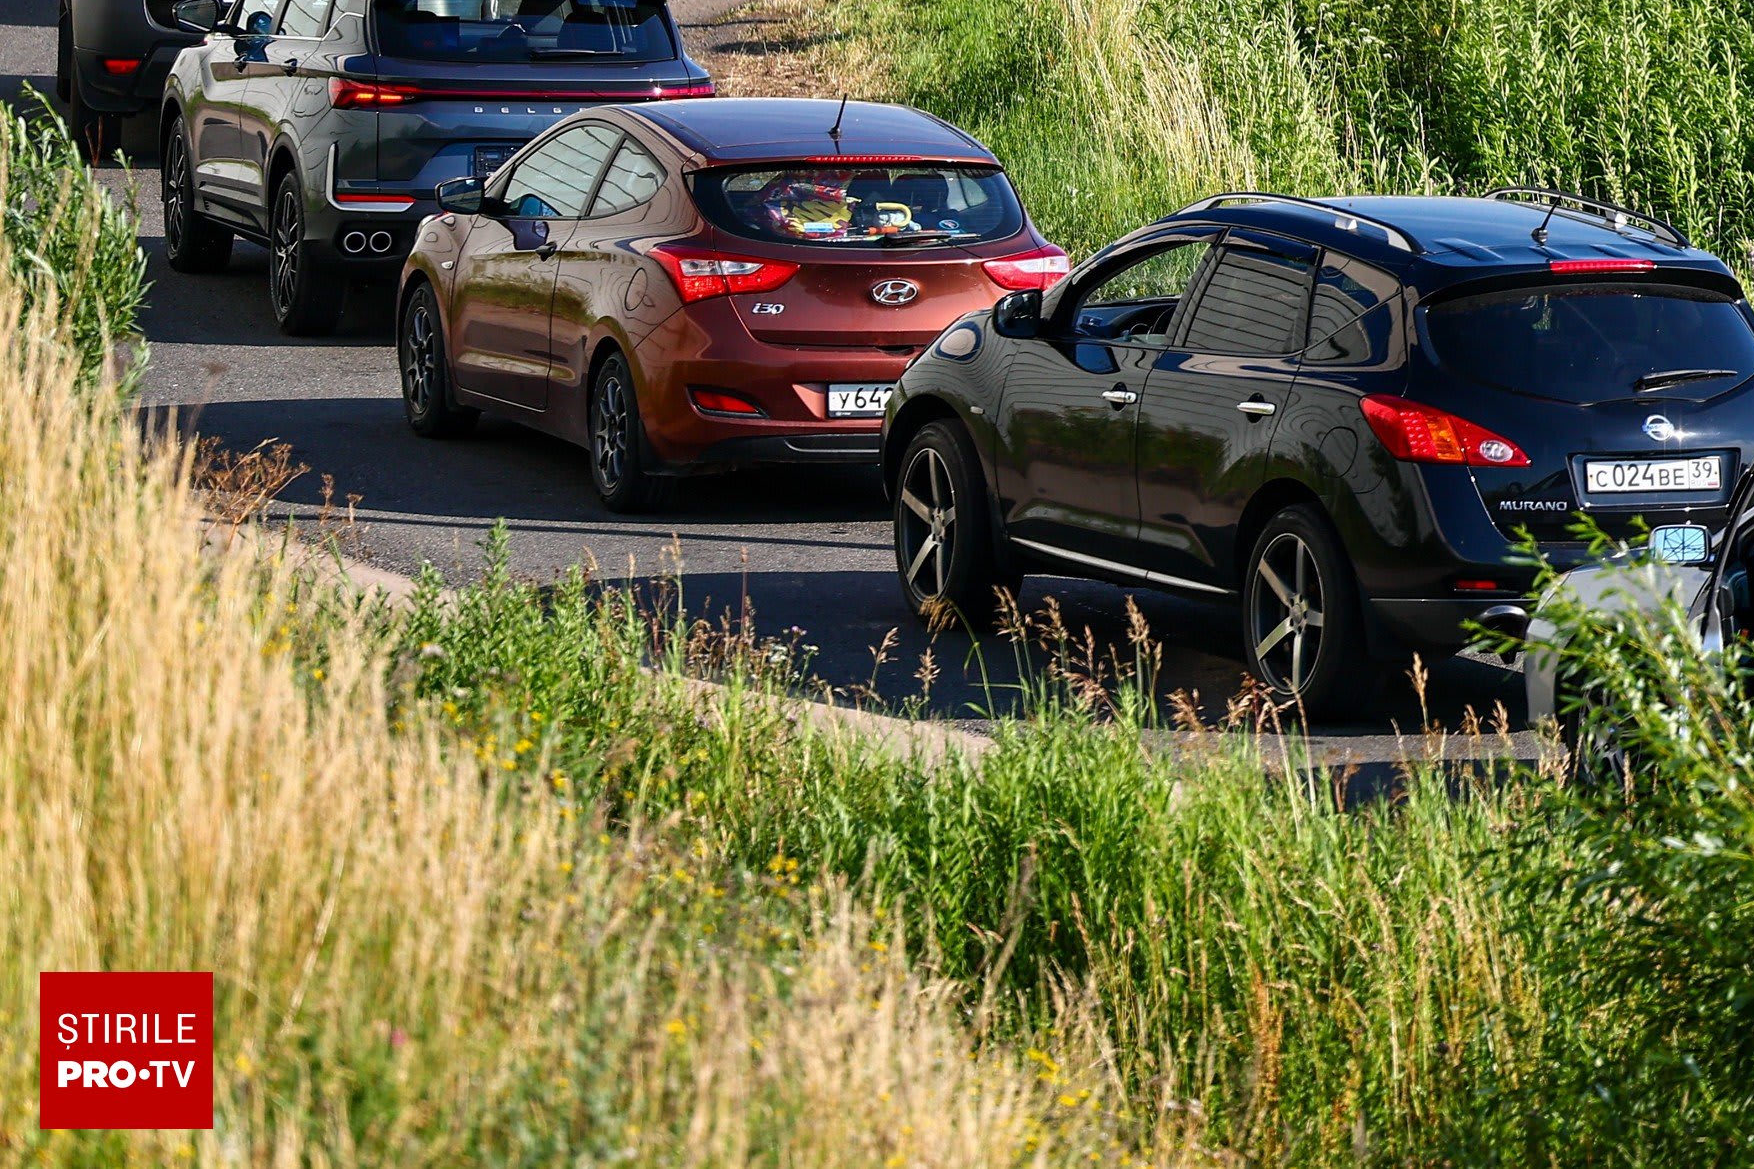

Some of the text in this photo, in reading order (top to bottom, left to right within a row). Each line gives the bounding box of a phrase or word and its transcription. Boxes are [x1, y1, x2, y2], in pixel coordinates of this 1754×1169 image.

[474, 106, 589, 114] BELG
[752, 303, 785, 315] i30
[839, 387, 893, 409] У642
[1691, 461, 1712, 478] 39
[1500, 501, 1567, 511] MURANO
